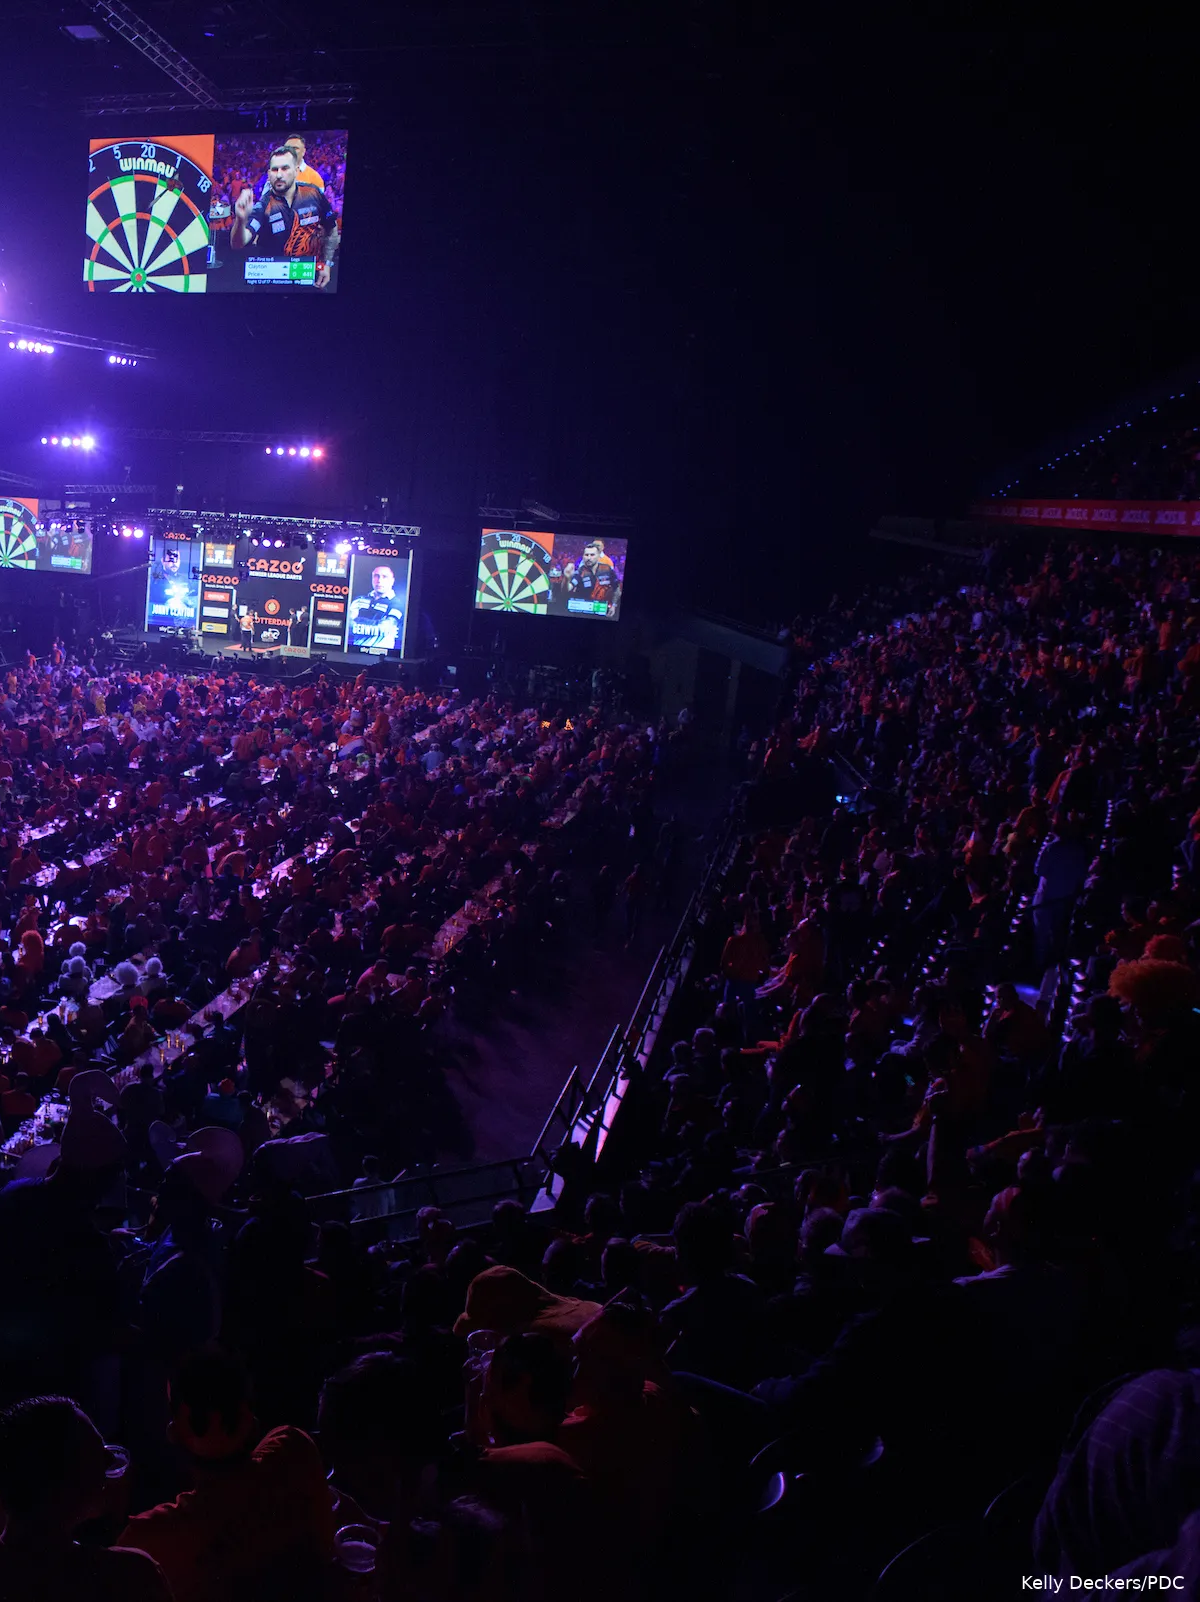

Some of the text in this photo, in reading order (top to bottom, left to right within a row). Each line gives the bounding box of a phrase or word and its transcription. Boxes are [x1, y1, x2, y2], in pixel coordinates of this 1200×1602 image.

[112, 144, 210, 193] 5 20 1 18
[119, 157, 175, 178] WINMAU
[367, 547, 398, 556] CAZOO
[246, 557, 304, 575] CAZOO
[201, 574, 239, 585] CAZOO
[310, 583, 349, 595] CAZOO
